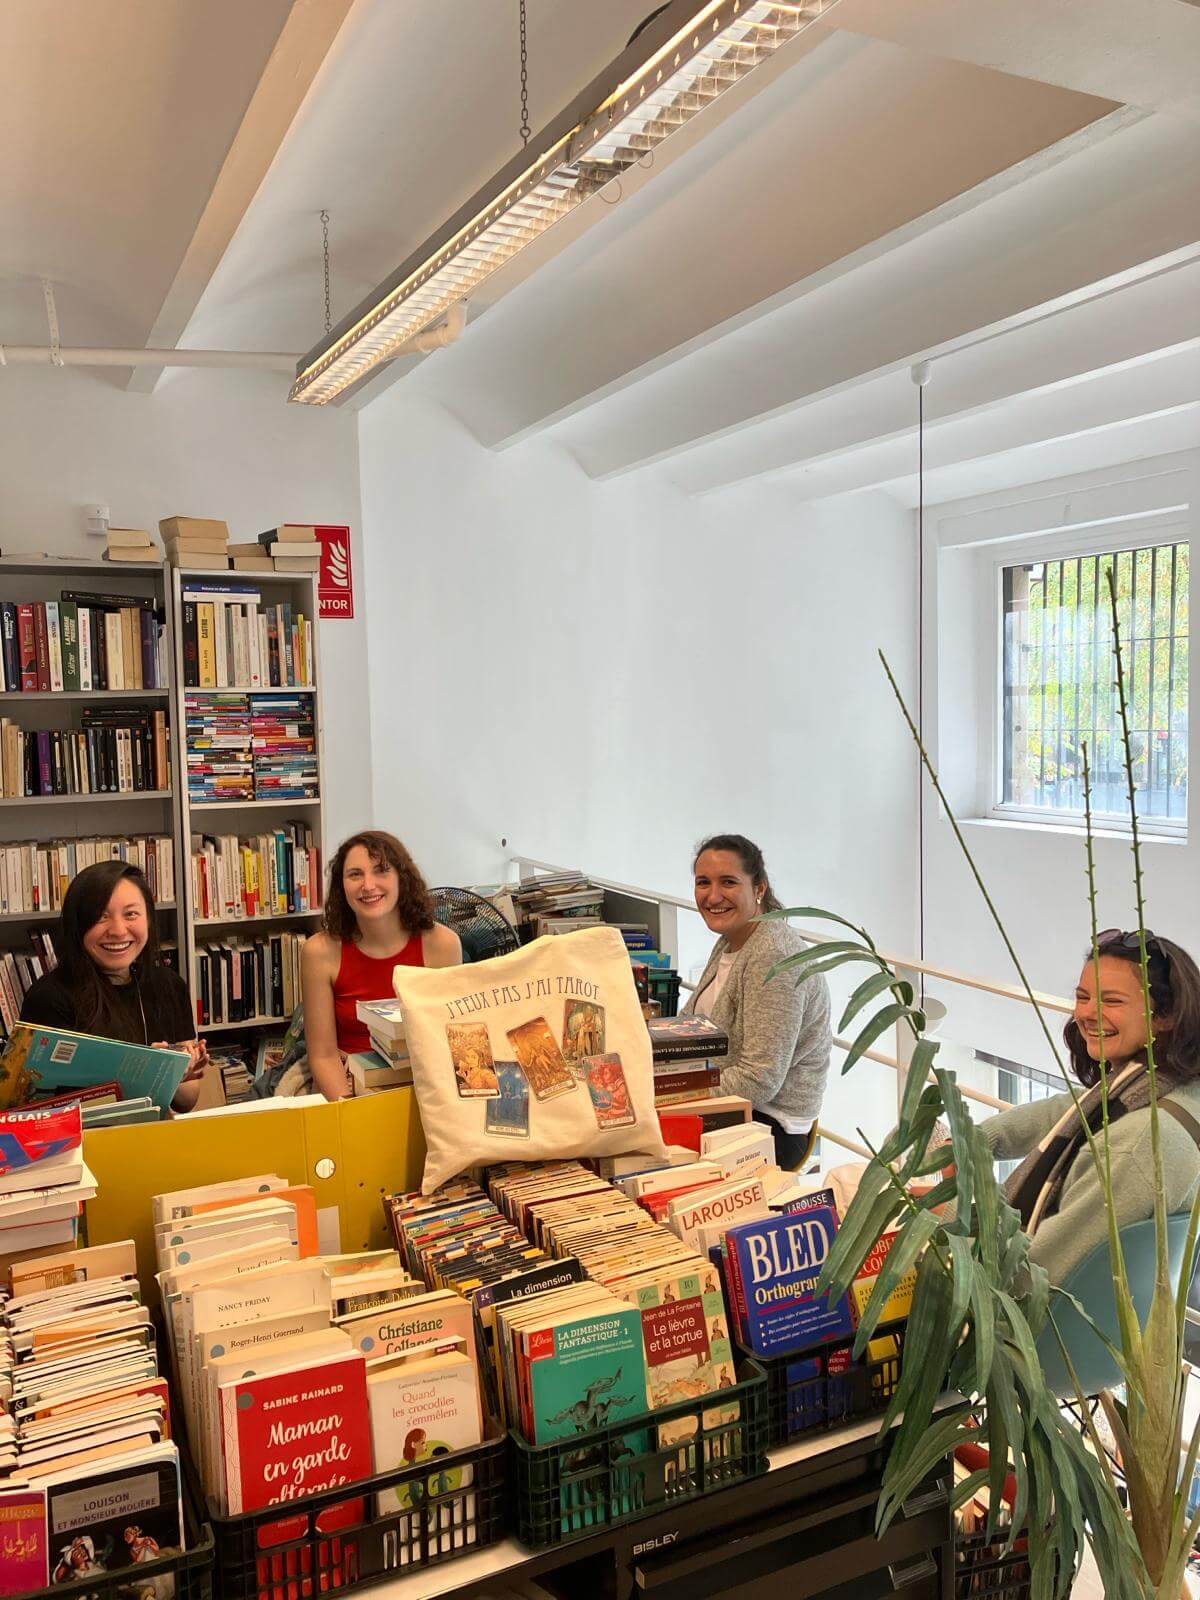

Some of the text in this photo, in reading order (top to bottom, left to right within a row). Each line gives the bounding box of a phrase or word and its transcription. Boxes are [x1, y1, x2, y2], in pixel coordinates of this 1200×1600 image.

[446, 976, 600, 1019] J'PEUX PAS J'AI TAROT
[682, 1185, 762, 1231] LAROUSSE
[786, 1192, 828, 1214] LAROUSSE
[745, 1220, 830, 1284] BLED
[524, 1272, 572, 1295] dimension
[218, 1296, 271, 1312] NANCY FRIDAY
[642, 1312, 658, 1323] Jean
[658, 1310, 666, 1318] de
[666, 1307, 675, 1315] La
[675, 1301, 702, 1311] Fontaine
[378, 1318, 444, 1341] Christiane
[558, 1319, 620, 1341] LA DIMENSION
[652, 1316, 696, 1337] Le lièvre
[558, 1329, 619, 1351] FANTASTIQUE
[649, 1340, 661, 1352] et
[661, 1336, 671, 1349] la
[672, 1328, 704, 1346] tortue
[263, 1384, 344, 1411] SABINE RAINARD
[402, 1386, 436, 1403] Quand
[392, 1396, 455, 1418] les crocodiles
[406, 1408, 457, 1427] s'emmêlent
[266, 1414, 343, 1448] Maman
[263, 1435, 352, 1484] en garde
[57, 1497, 156, 1530] ET MONSIEUR MOLIÈRE
[83, 1492, 130, 1512] LOUISON
[633, 1530, 680, 1555] BISLEY
